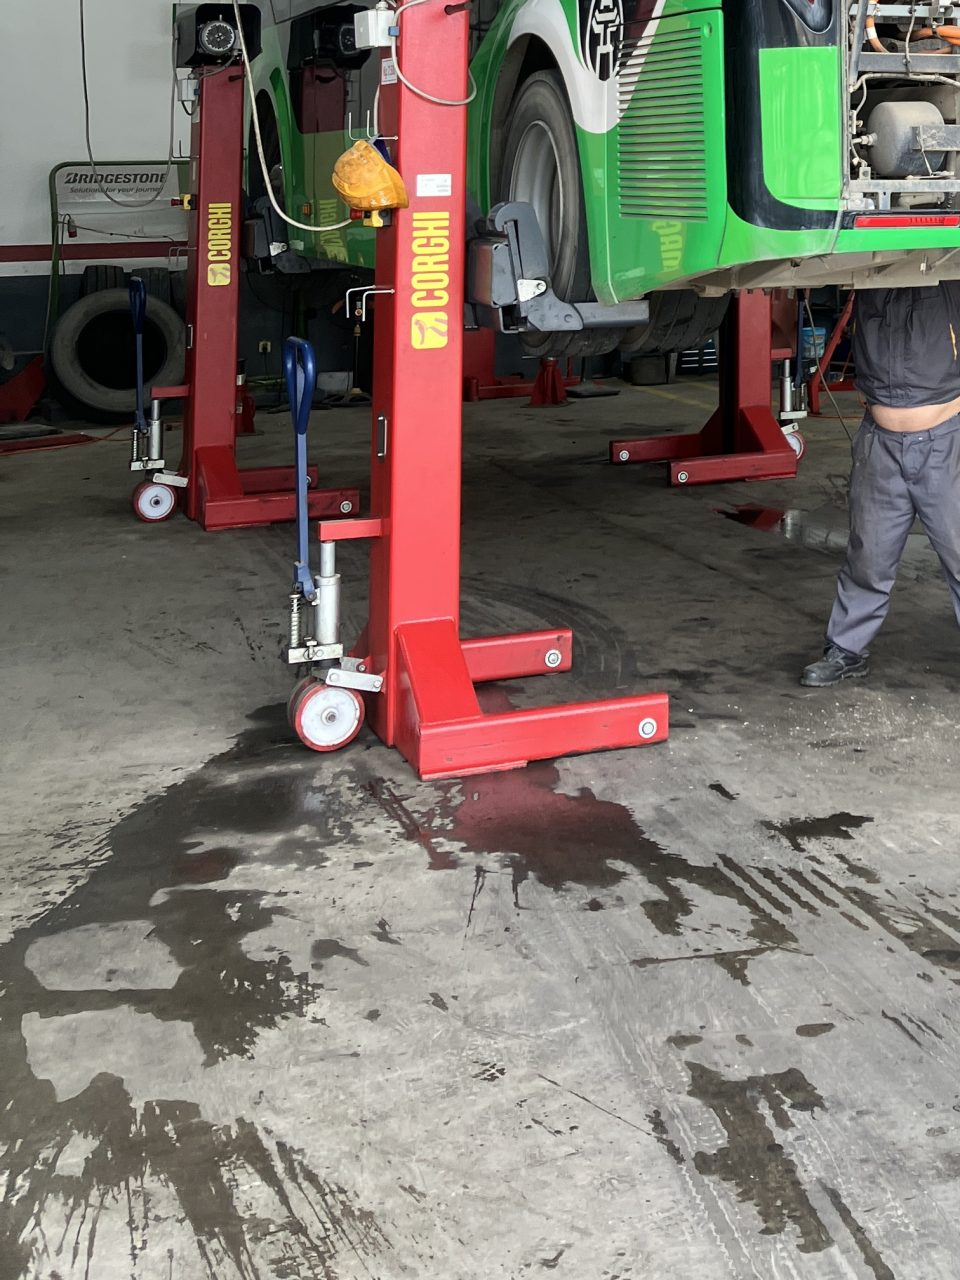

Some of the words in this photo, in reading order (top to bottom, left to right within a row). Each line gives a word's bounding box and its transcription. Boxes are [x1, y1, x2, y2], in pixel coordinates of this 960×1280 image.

[64, 172, 167, 185] BRIDGESTONE
[135, 186, 163, 195] journe
[208, 202, 232, 261] CORGHI
[411, 211, 450, 308] CORGHI
